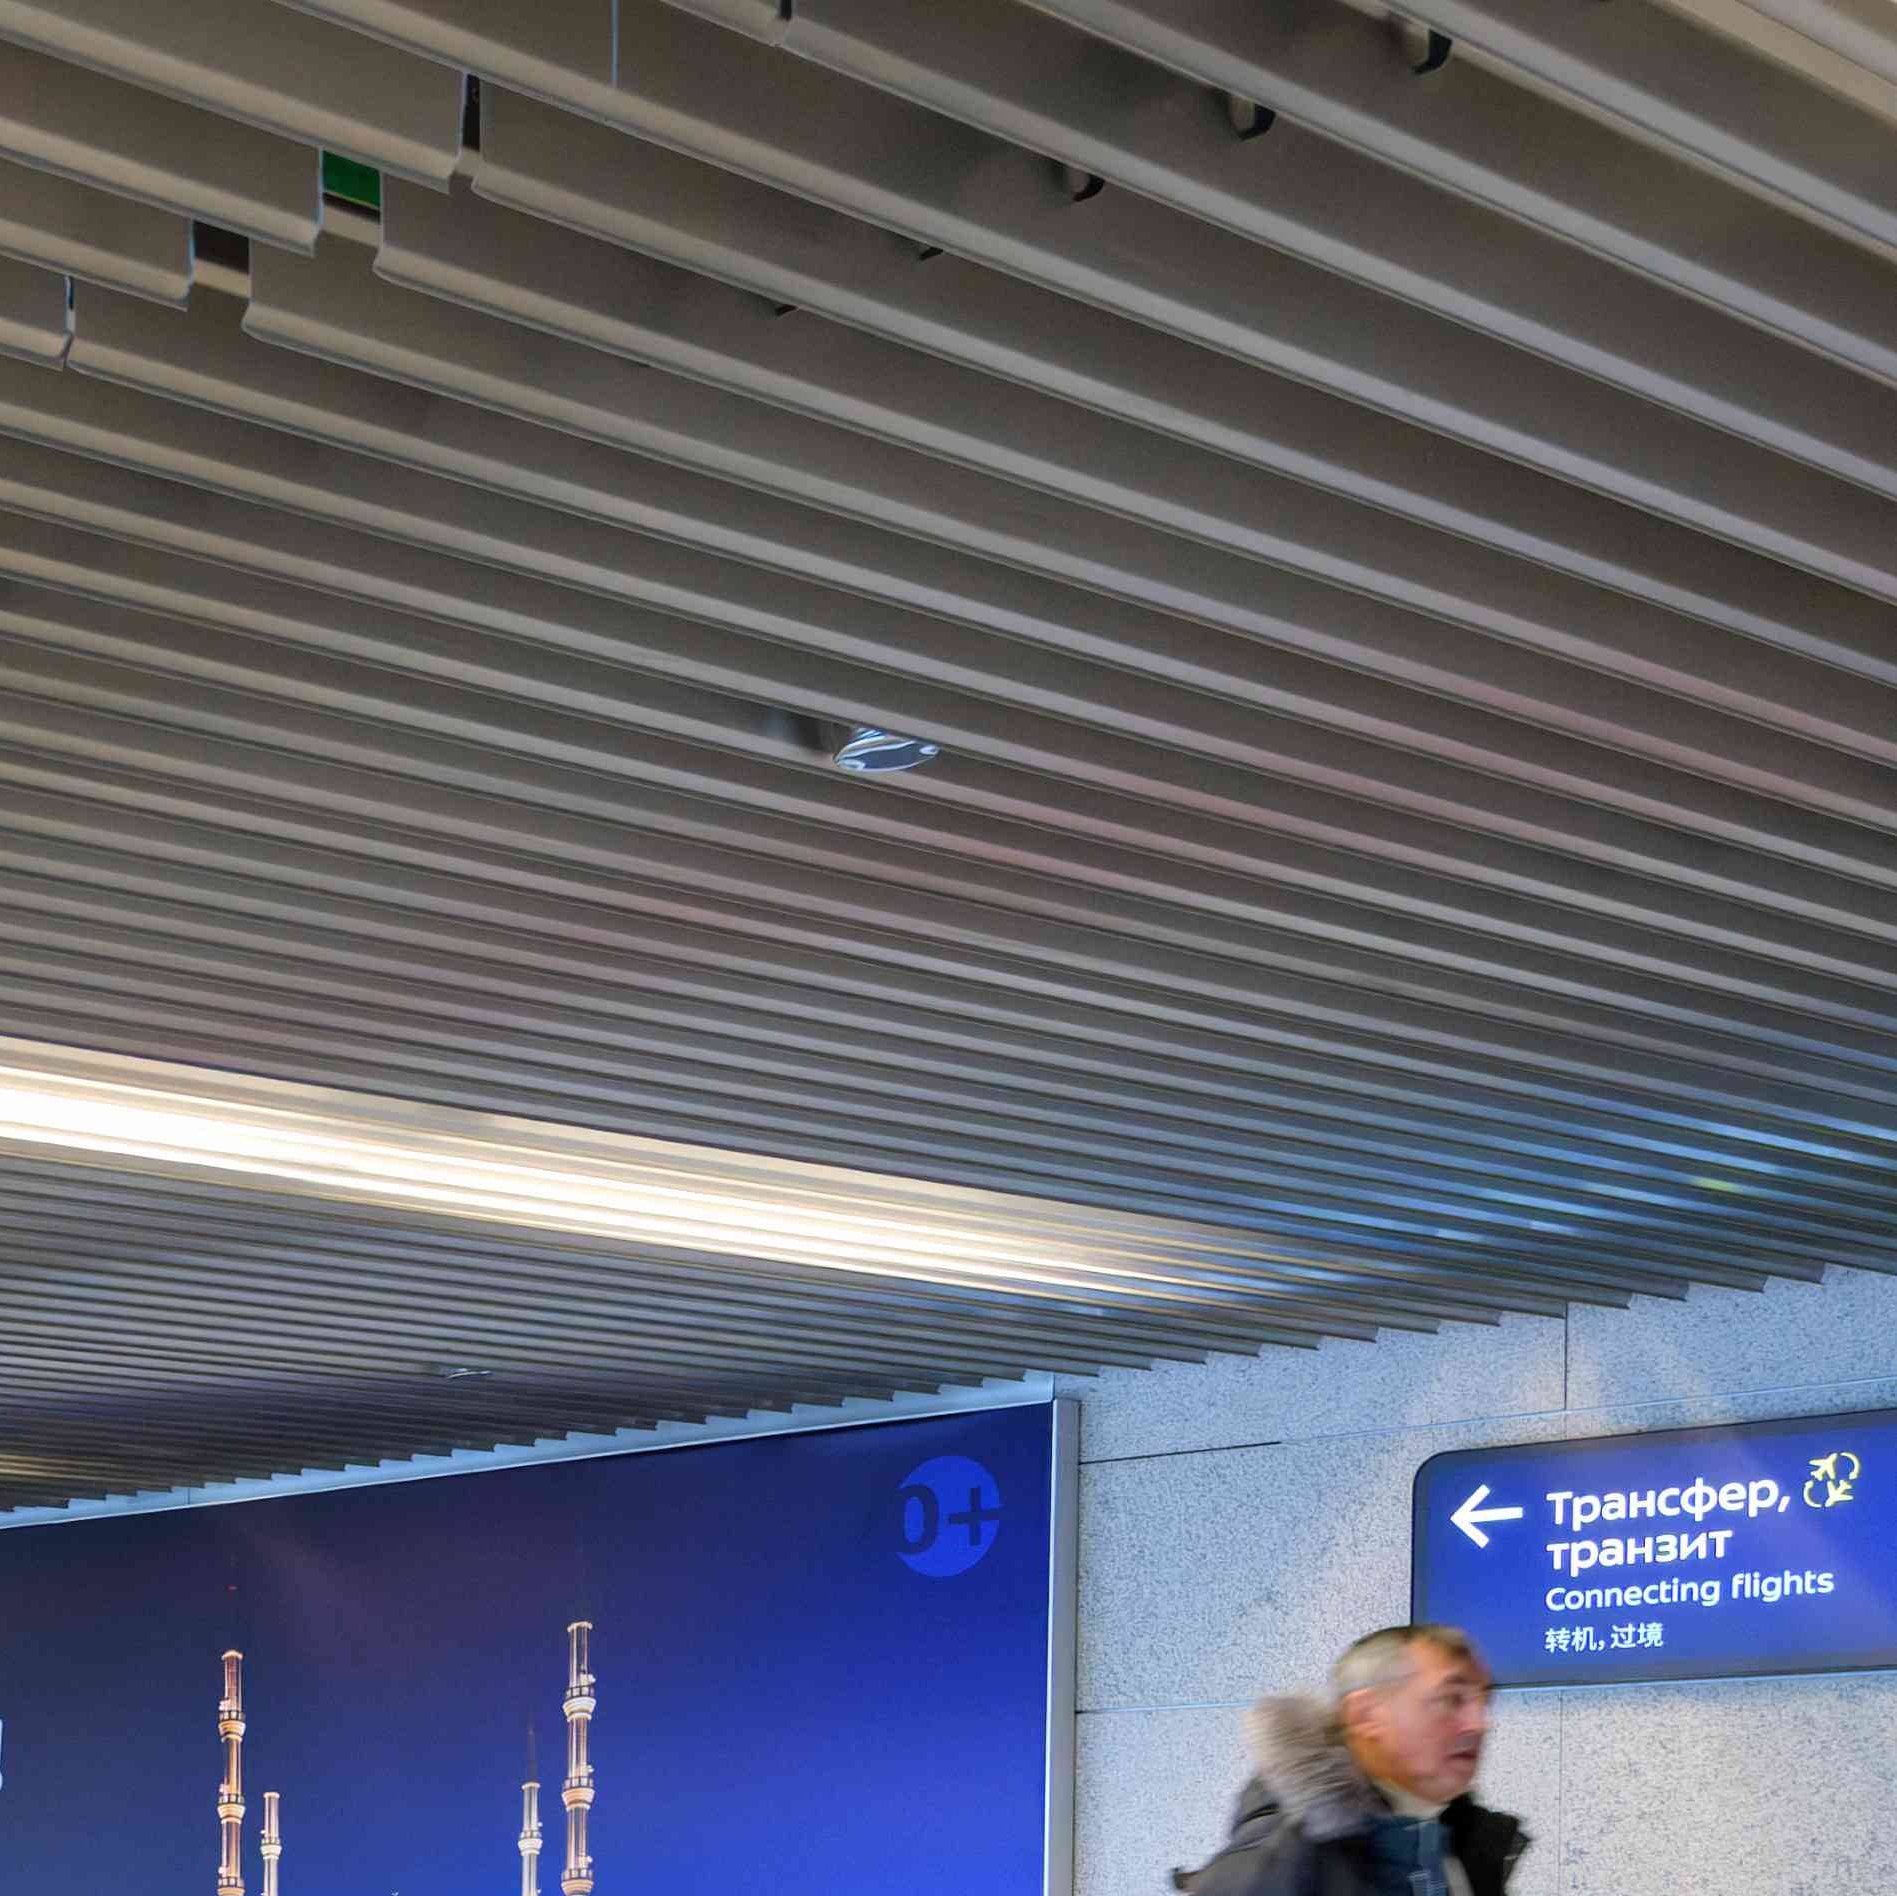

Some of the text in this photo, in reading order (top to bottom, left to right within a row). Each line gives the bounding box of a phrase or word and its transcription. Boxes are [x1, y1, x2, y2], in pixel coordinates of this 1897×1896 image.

[892, 1482, 1006, 1555] 0+
[1546, 1478, 1791, 1531] Трансфер,
[1546, 1529, 1733, 1577] транзит
[1545, 1569, 1835, 1612] Connecting flights
